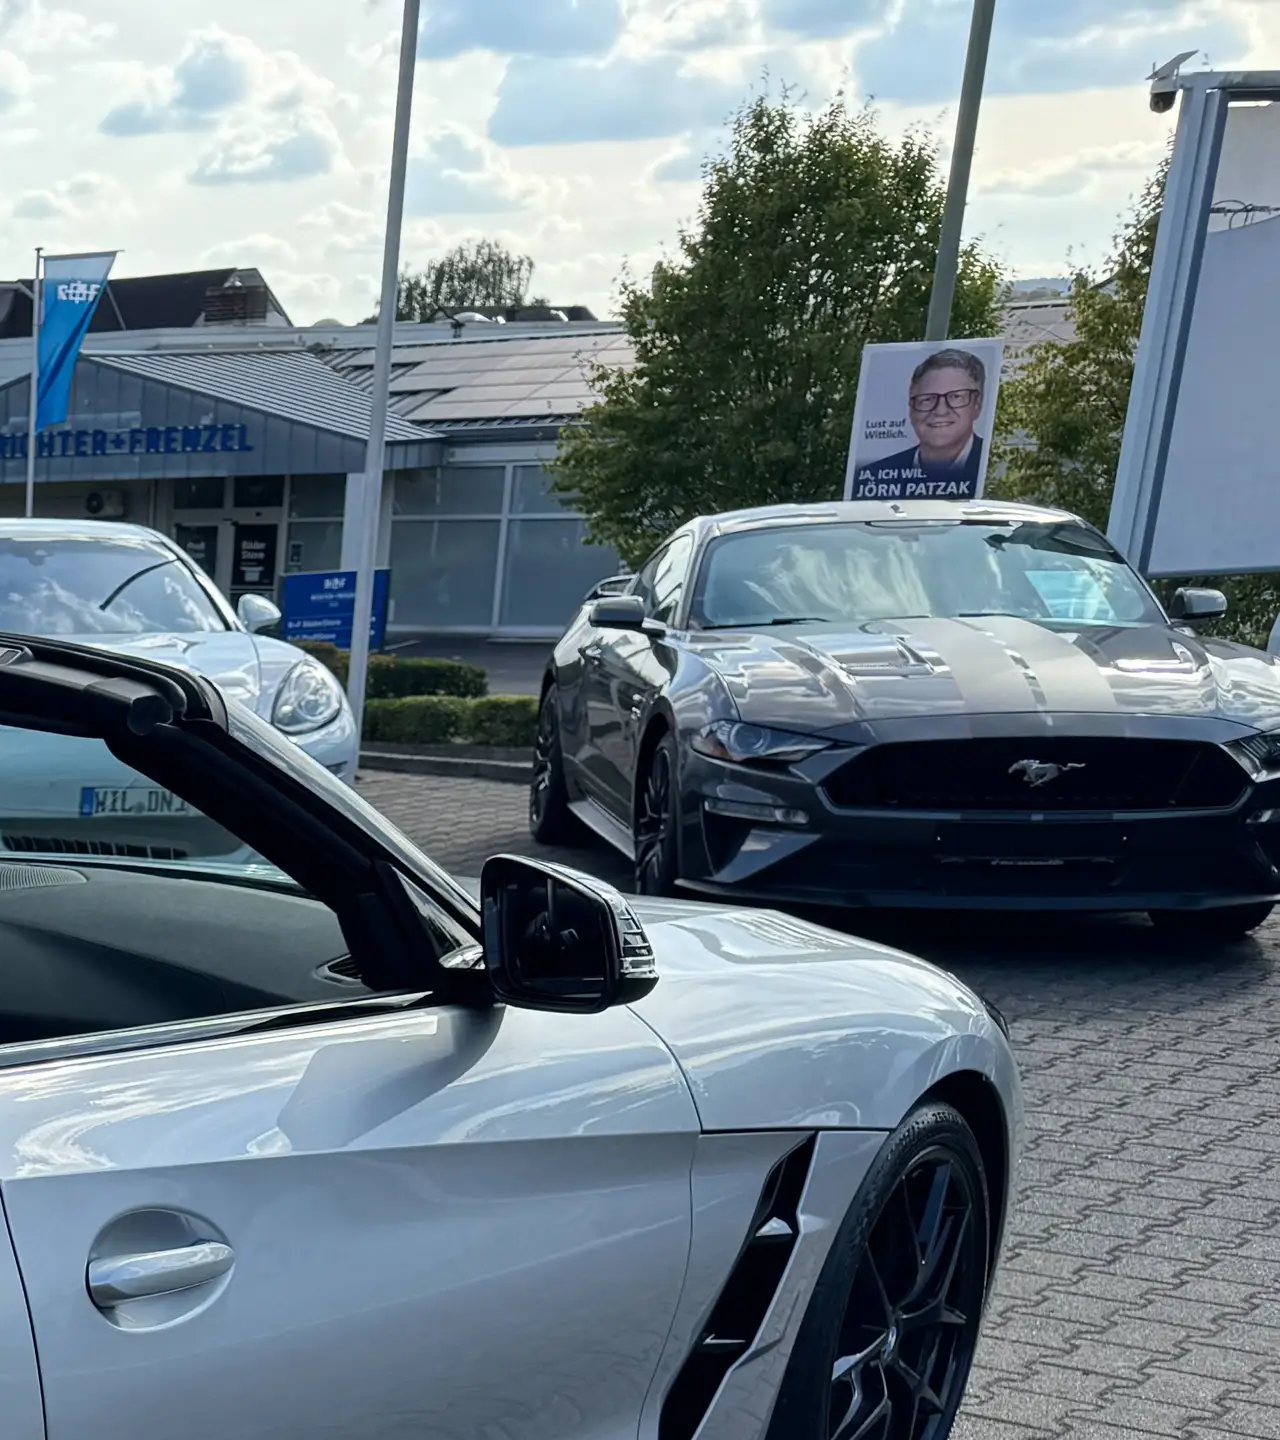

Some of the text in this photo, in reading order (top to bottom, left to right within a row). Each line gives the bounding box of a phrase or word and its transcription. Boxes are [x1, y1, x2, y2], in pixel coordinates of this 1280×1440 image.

[865, 418, 906, 429] Lust auf
[864, 429, 908, 439] Wittlich.
[858, 468, 927, 480] JA, ICH WIL.
[857, 481, 971, 497] JÖRN PATZAK
[94, 789, 133, 814] WIL
